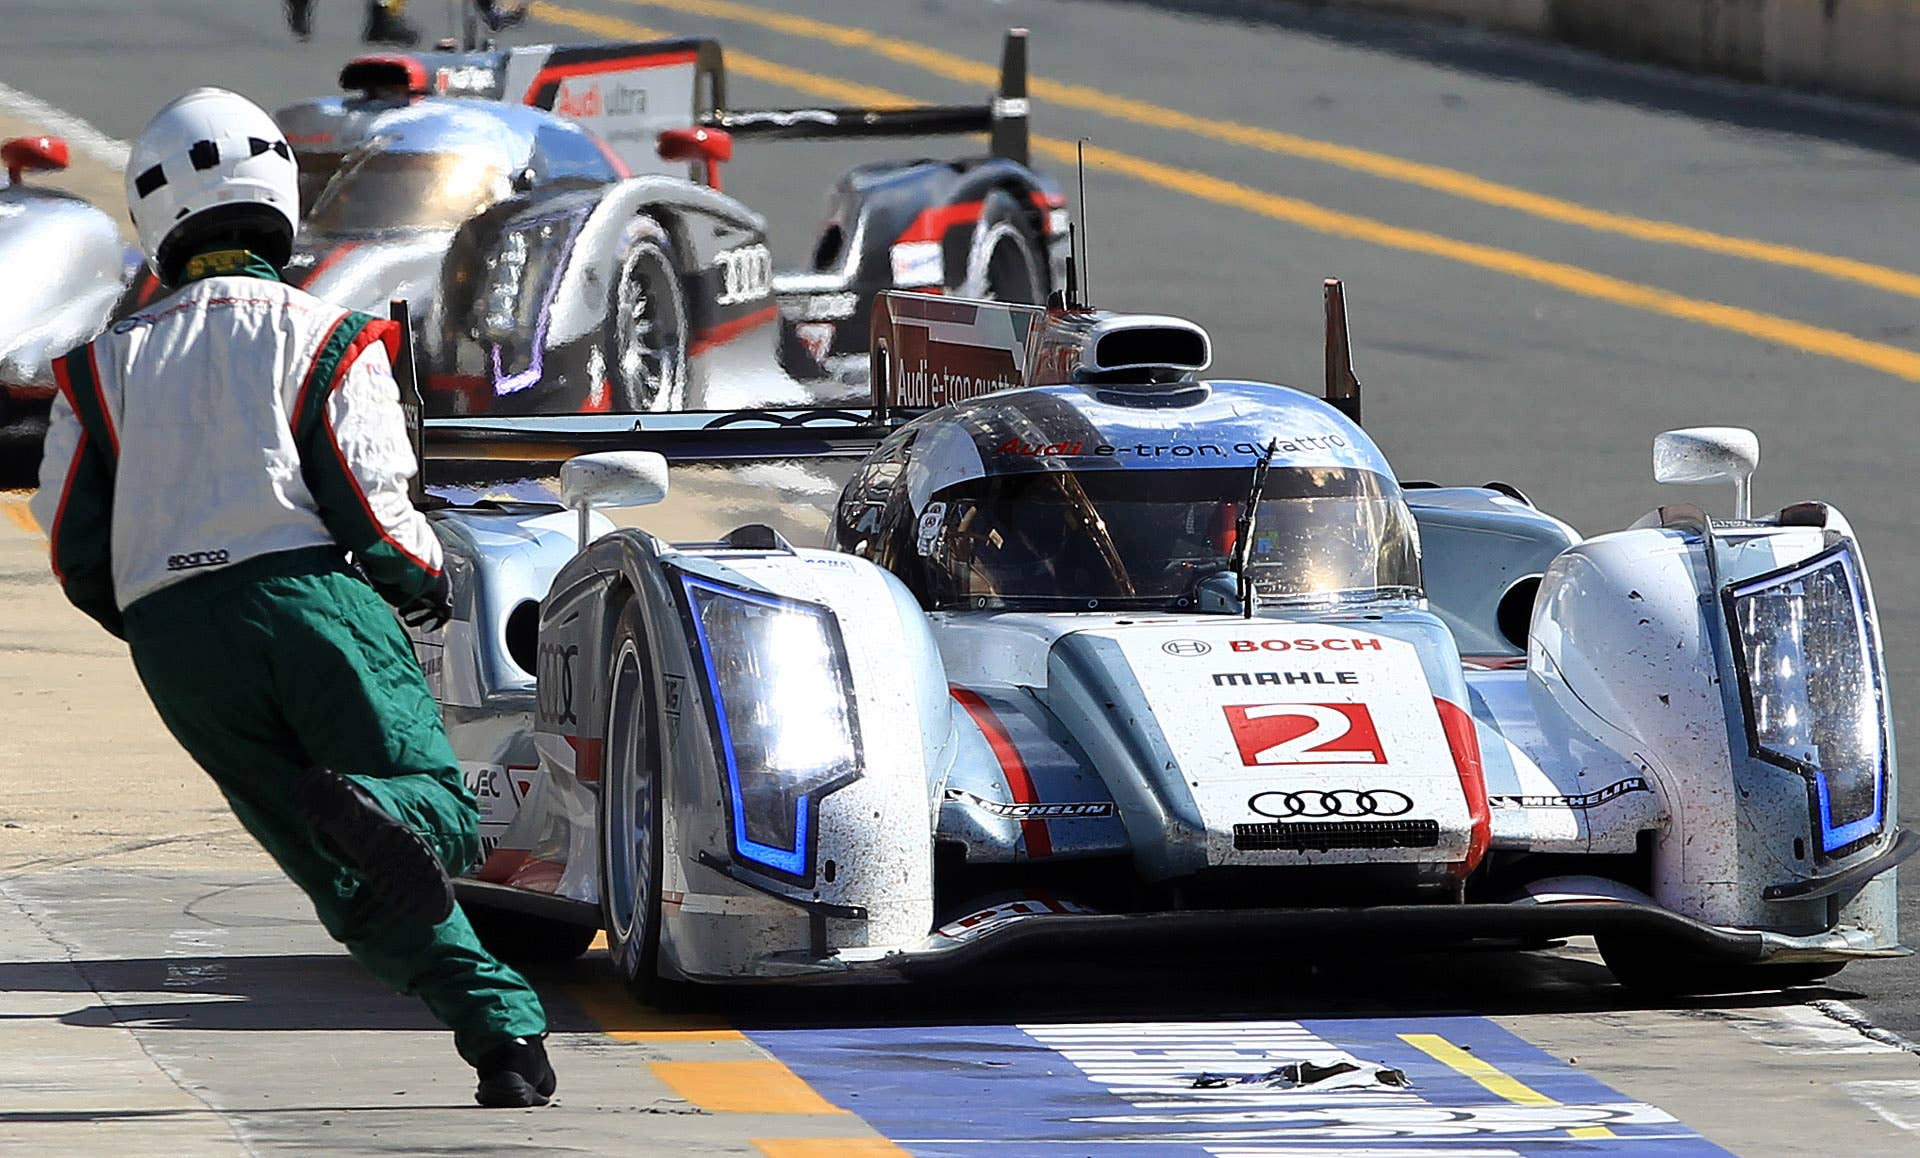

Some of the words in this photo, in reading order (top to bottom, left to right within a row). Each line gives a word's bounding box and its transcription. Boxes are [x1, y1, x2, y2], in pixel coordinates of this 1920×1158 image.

[897, 358, 928, 407] Audi
[931, 366, 972, 408] e-tron
[996, 438, 1084, 457] Audi
[1094, 442, 1222, 458] e-tron
[1233, 434, 1346, 459] quattro
[167, 549, 229, 570] sparco
[1229, 639, 1383, 652] BOSCH
[1212, 671, 1359, 686] MAHLE
[1243, 703, 1377, 764] 2
[463, 769, 500, 798] WEC
[1522, 778, 1640, 806] MICHELIN
[978, 801, 1106, 816] MICHELIN
